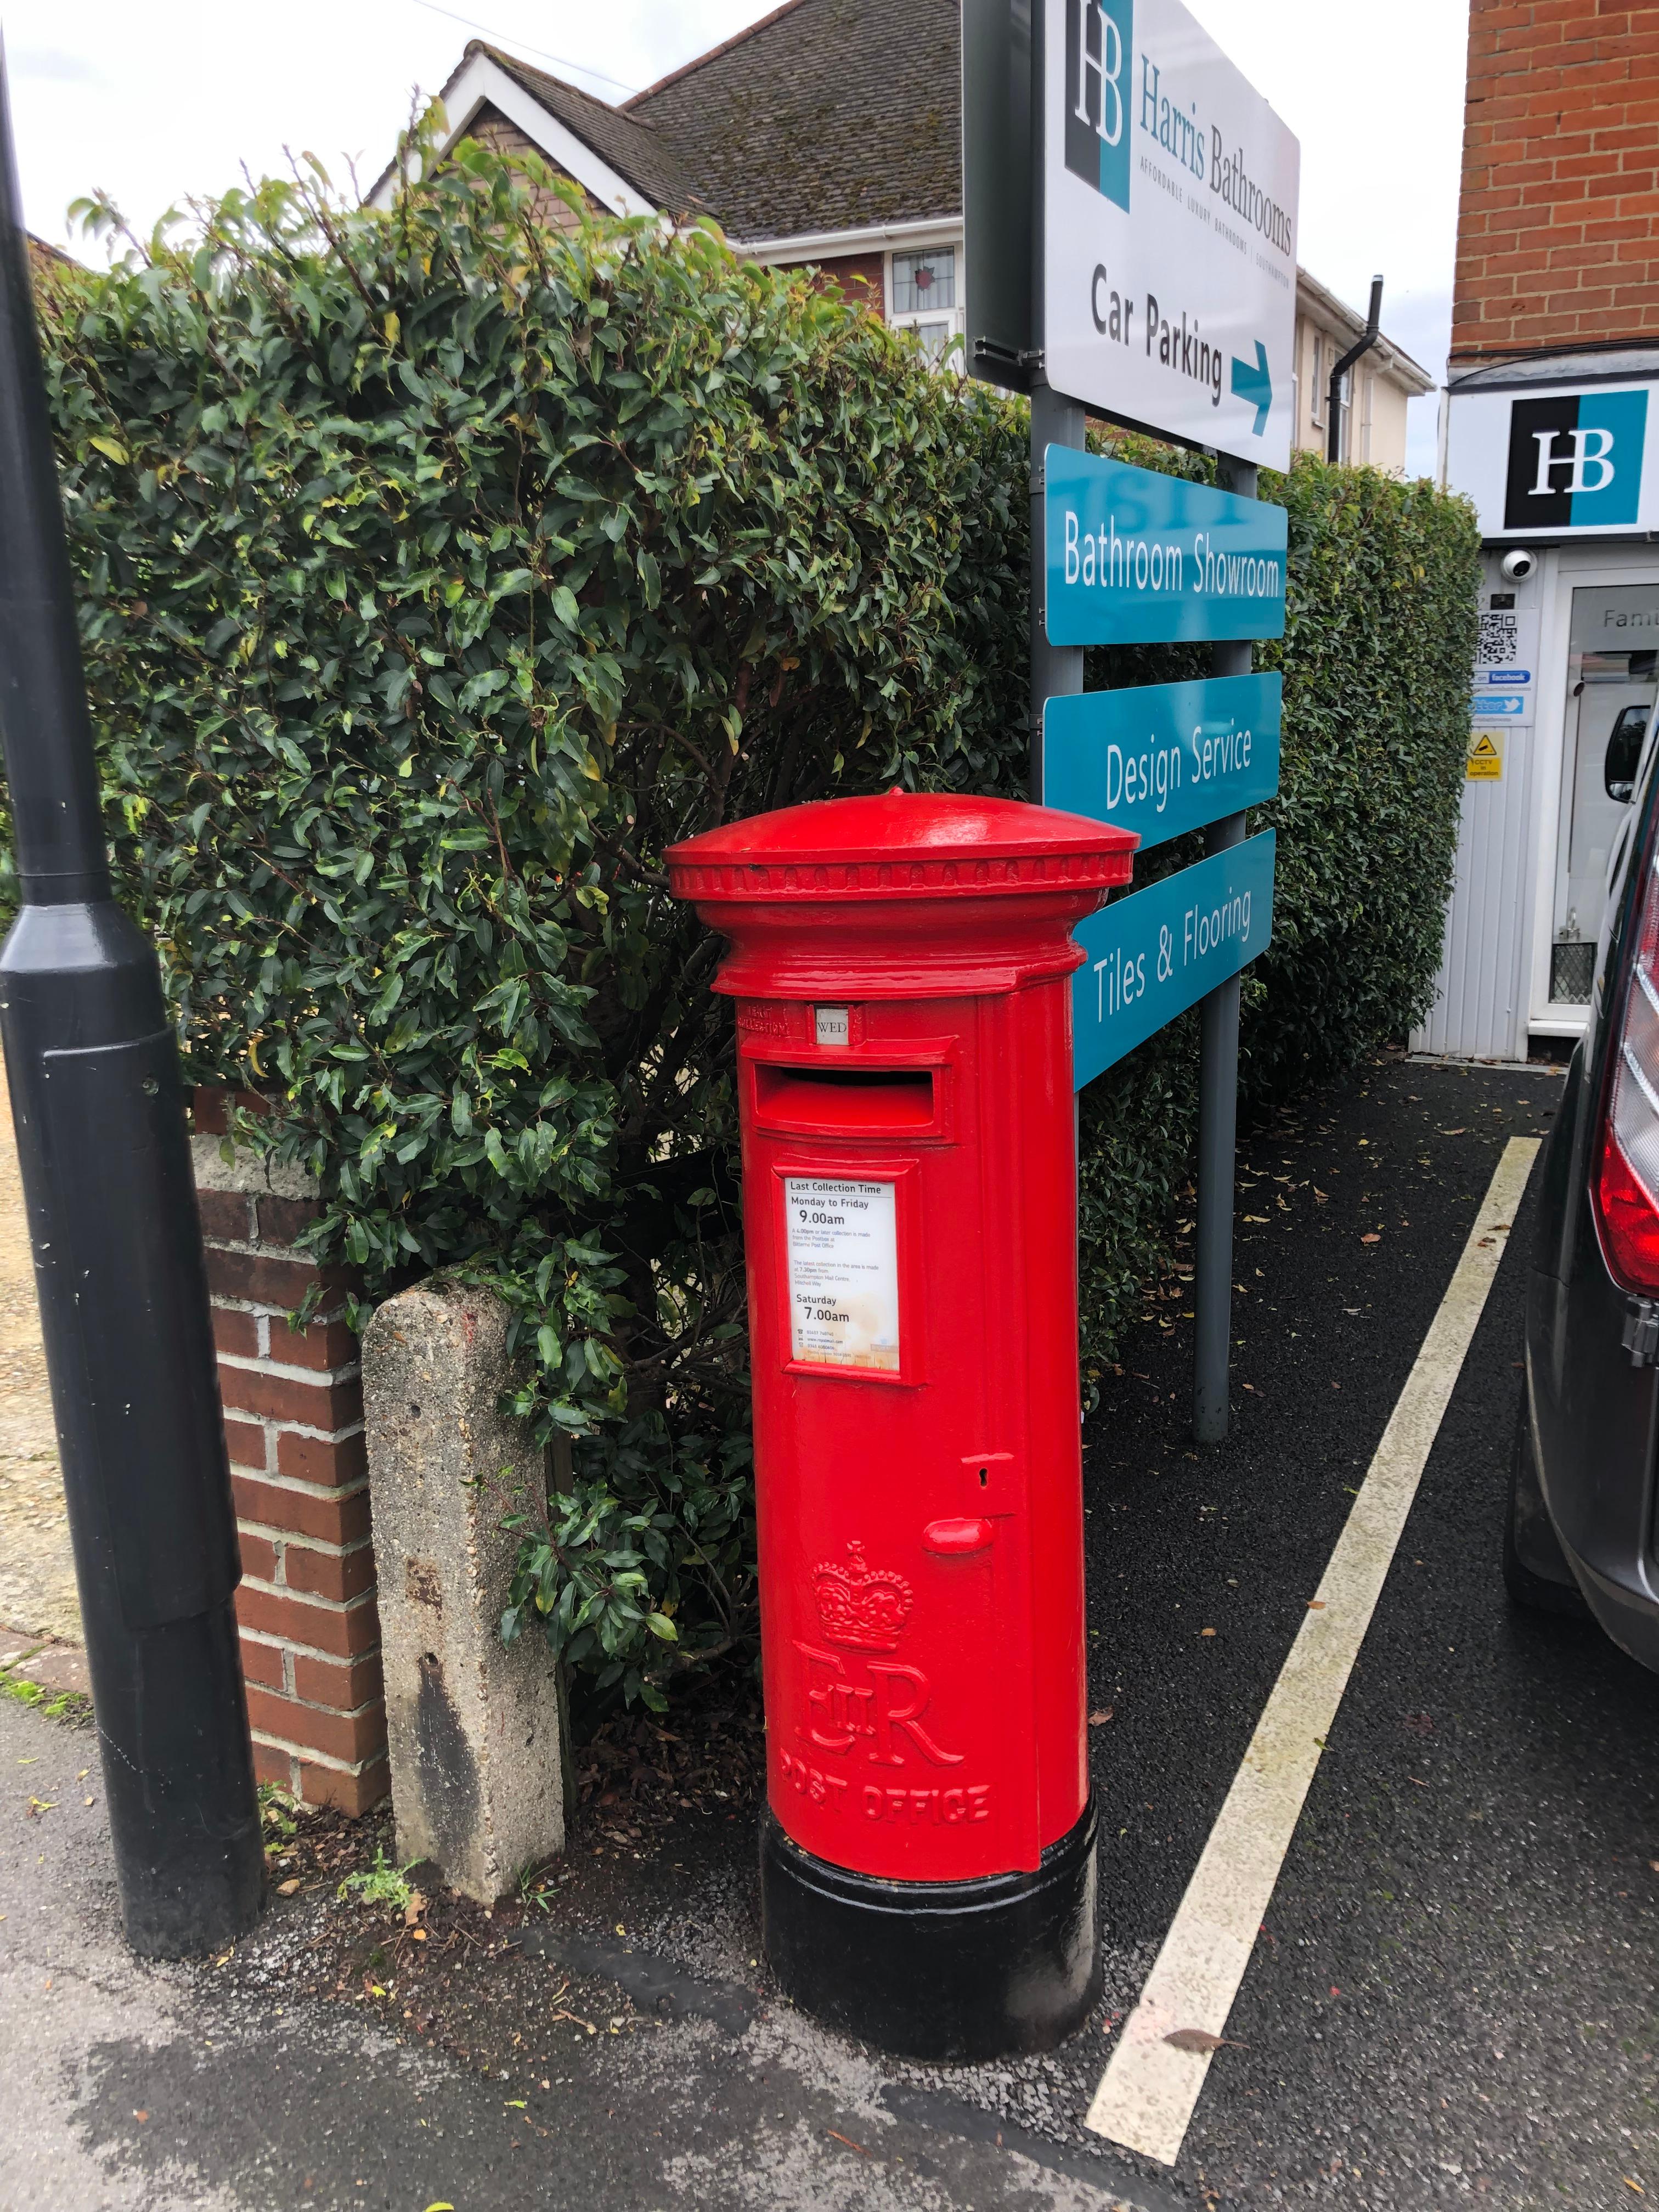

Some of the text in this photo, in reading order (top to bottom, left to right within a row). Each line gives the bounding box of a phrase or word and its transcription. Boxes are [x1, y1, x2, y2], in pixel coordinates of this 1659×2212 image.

[1074, 0, 1122, 147] HB
[1140, 53, 1291, 257] Harris Bathrooms
[1141, 156, 1289, 290] AFFORDABLE LUXURY BATHROOMS SOUTHAMPTON
[1091, 263, 1222, 408] Car Parking
[1527, 428, 1615, 495] HB
[1065, 510, 1279, 598] Bathroom Showroom
[1492, 673, 1526, 681] facebook
[1106, 718, 1251, 813] Design Service
[1093, 886, 1251, 1024] Tiles & Flooring
[817, 1022, 847, 1033] WED
[791, 1181, 881, 1194] Last Collection Time
[791, 1197, 868, 1210] Monday to Friday
[799, 1210, 844, 1224] 9.00am
[797, 1294, 837, 1306] Saturday
[804, 1307, 849, 1322] 7.00am
[780, 1747, 992, 1826] POST OFFICE
